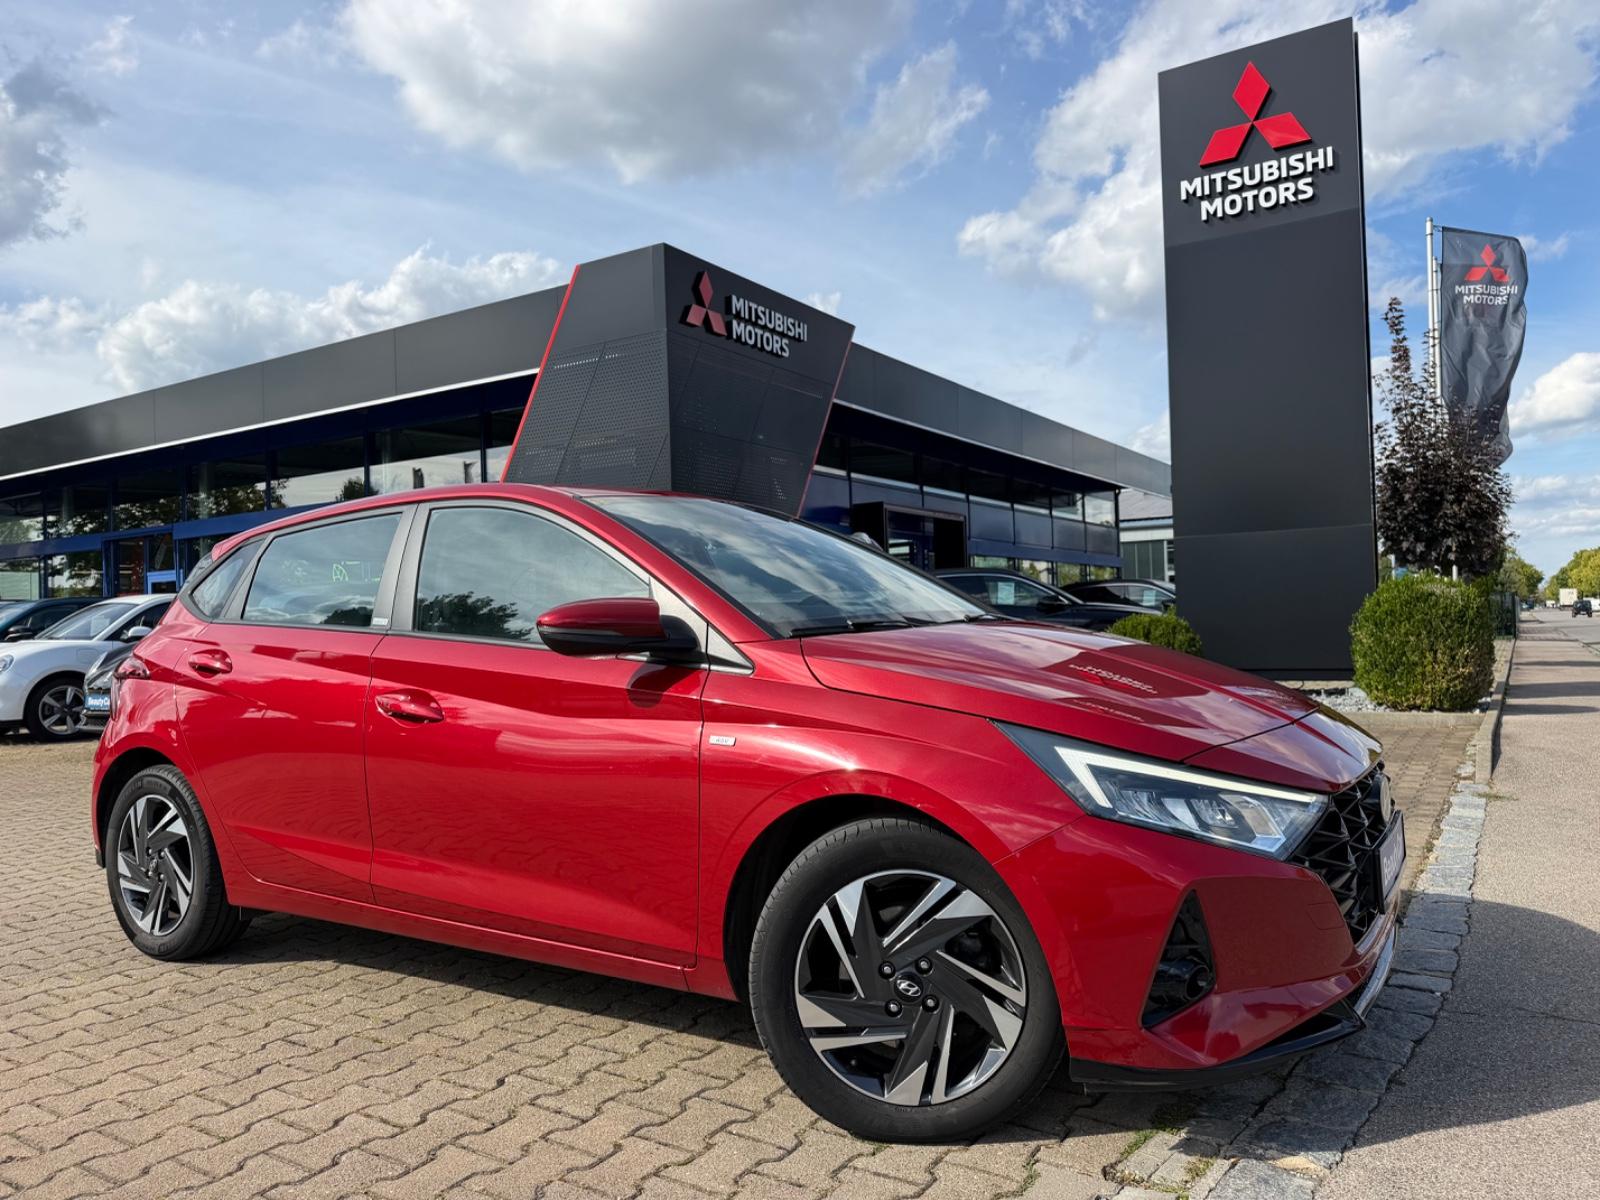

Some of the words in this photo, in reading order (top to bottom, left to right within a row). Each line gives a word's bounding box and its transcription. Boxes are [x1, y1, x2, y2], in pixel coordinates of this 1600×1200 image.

[1180, 146, 1334, 200] MITSUBISHI
[1201, 177, 1314, 221] MOTORS
[1455, 284, 1518, 295] MITSUBISHI
[1463, 295, 1509, 305] MOTORS
[731, 294, 808, 342] MITSUBISHI
[732, 319, 790, 358] MOTORS
